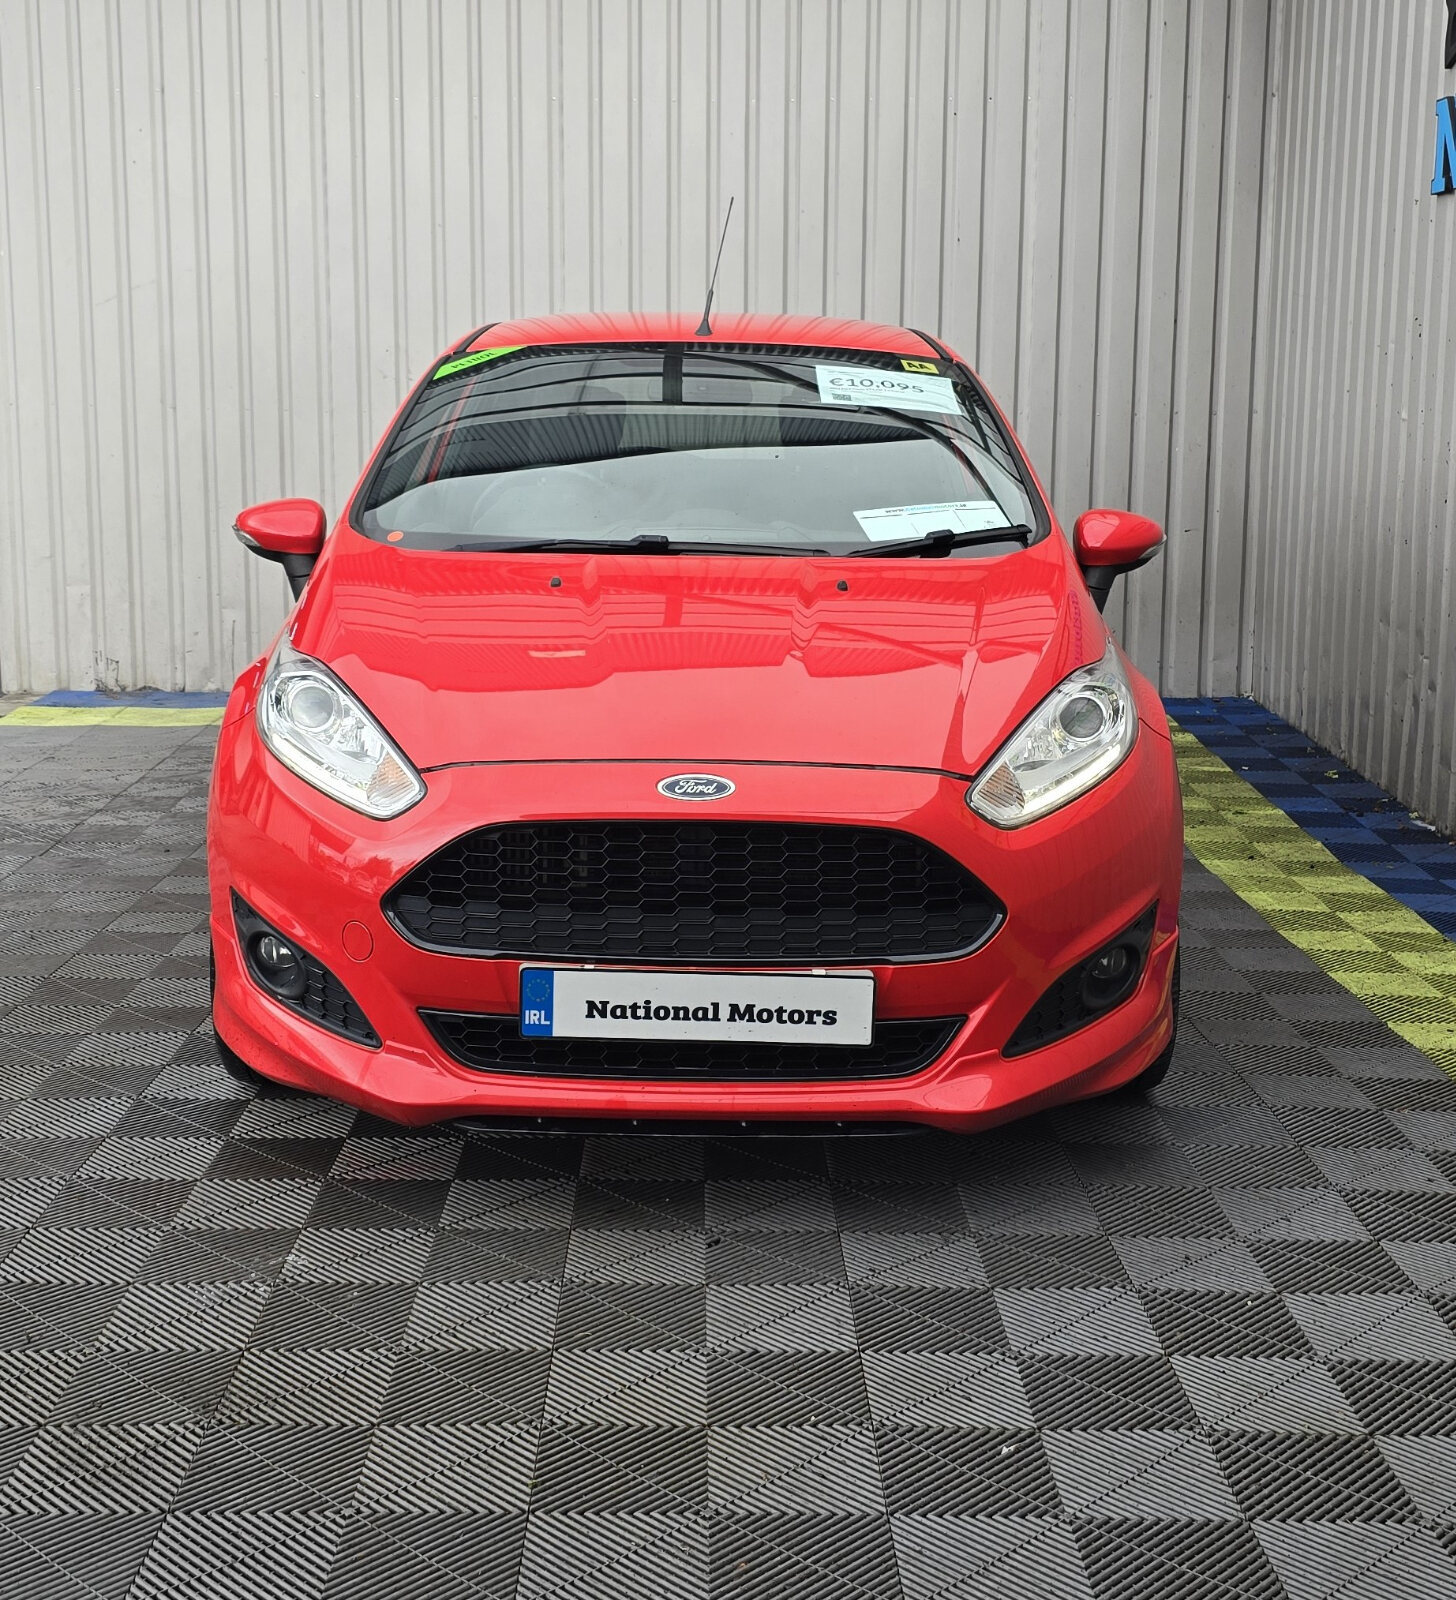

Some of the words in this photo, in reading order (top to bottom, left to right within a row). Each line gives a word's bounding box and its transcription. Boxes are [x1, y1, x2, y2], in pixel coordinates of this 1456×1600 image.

[905, 361, 931, 371] AA
[674, 779, 717, 794] Ford
[524, 1009, 551, 1025] IRL
[585, 1000, 721, 1022] National
[726, 1003, 838, 1026] Motors
